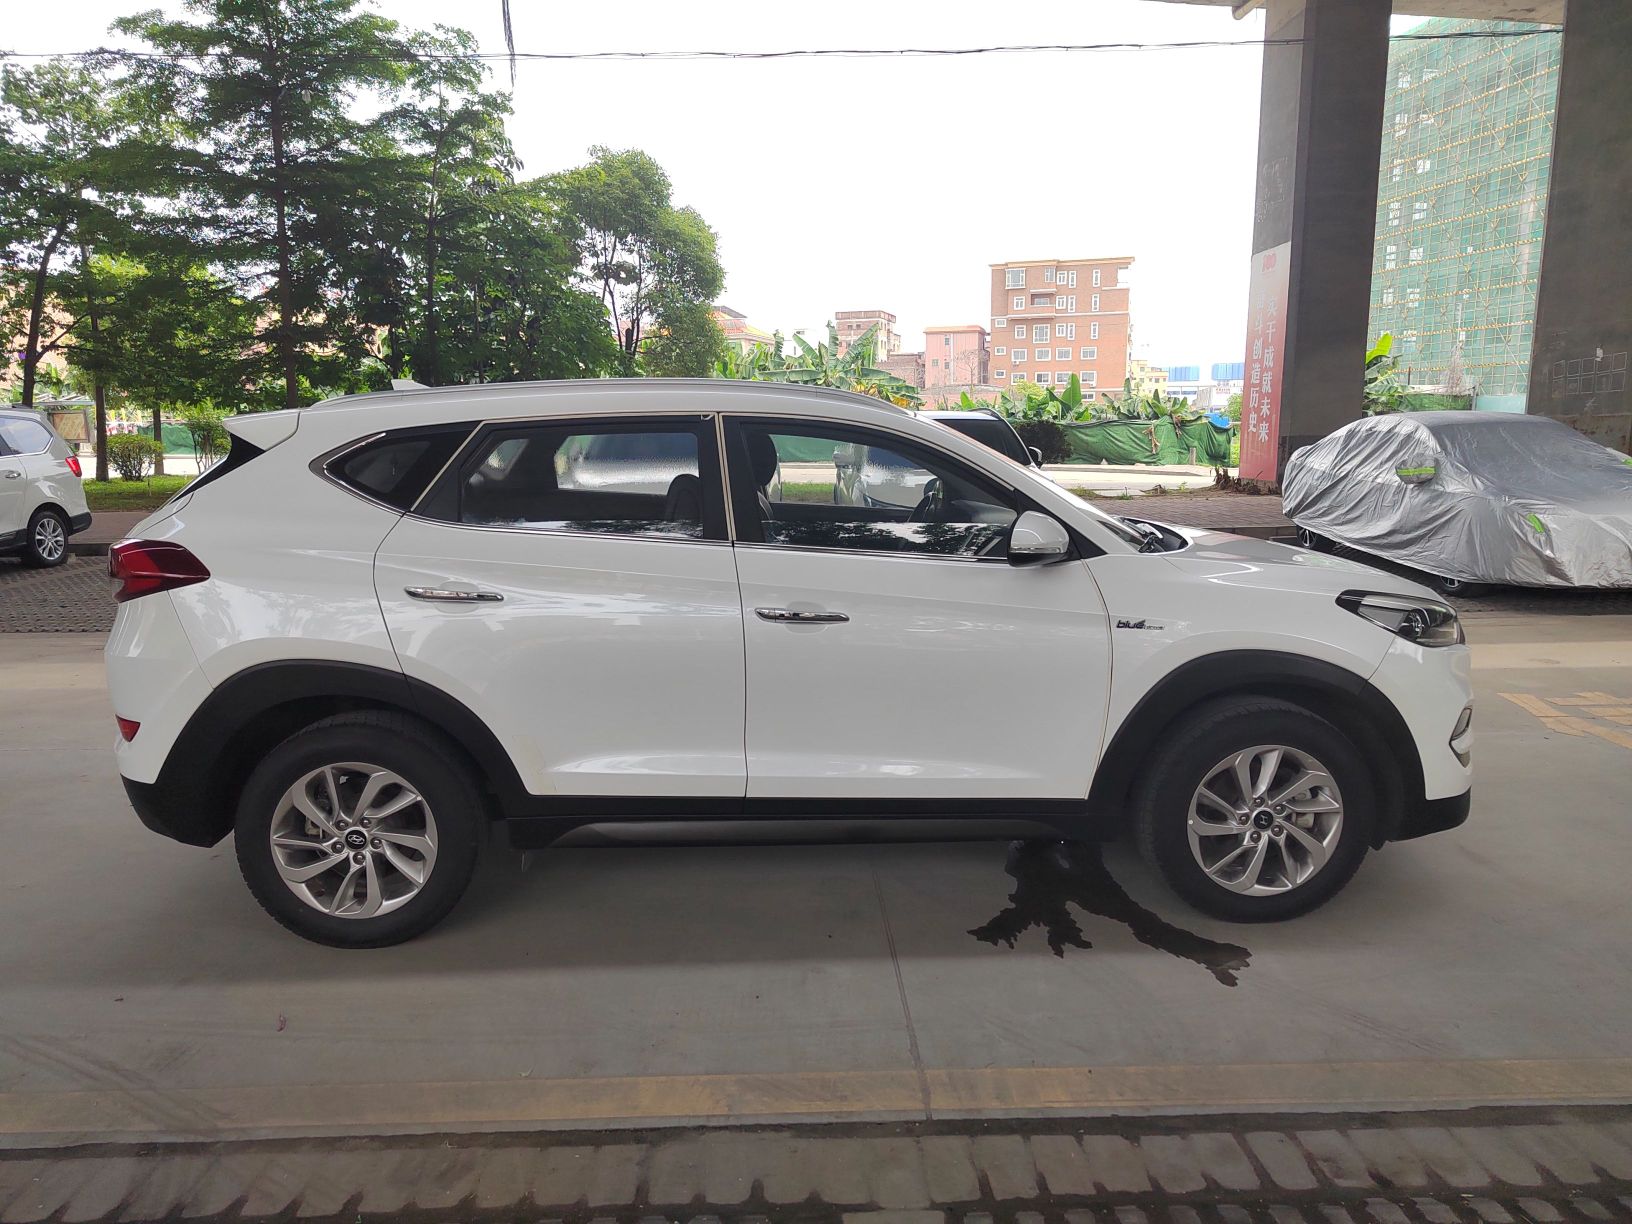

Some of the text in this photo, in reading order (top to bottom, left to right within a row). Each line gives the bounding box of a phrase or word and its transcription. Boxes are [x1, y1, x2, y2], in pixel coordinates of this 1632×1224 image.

[1259, 295, 1277, 443] 实干成就未来
[1116, 619, 1146, 630] blue
